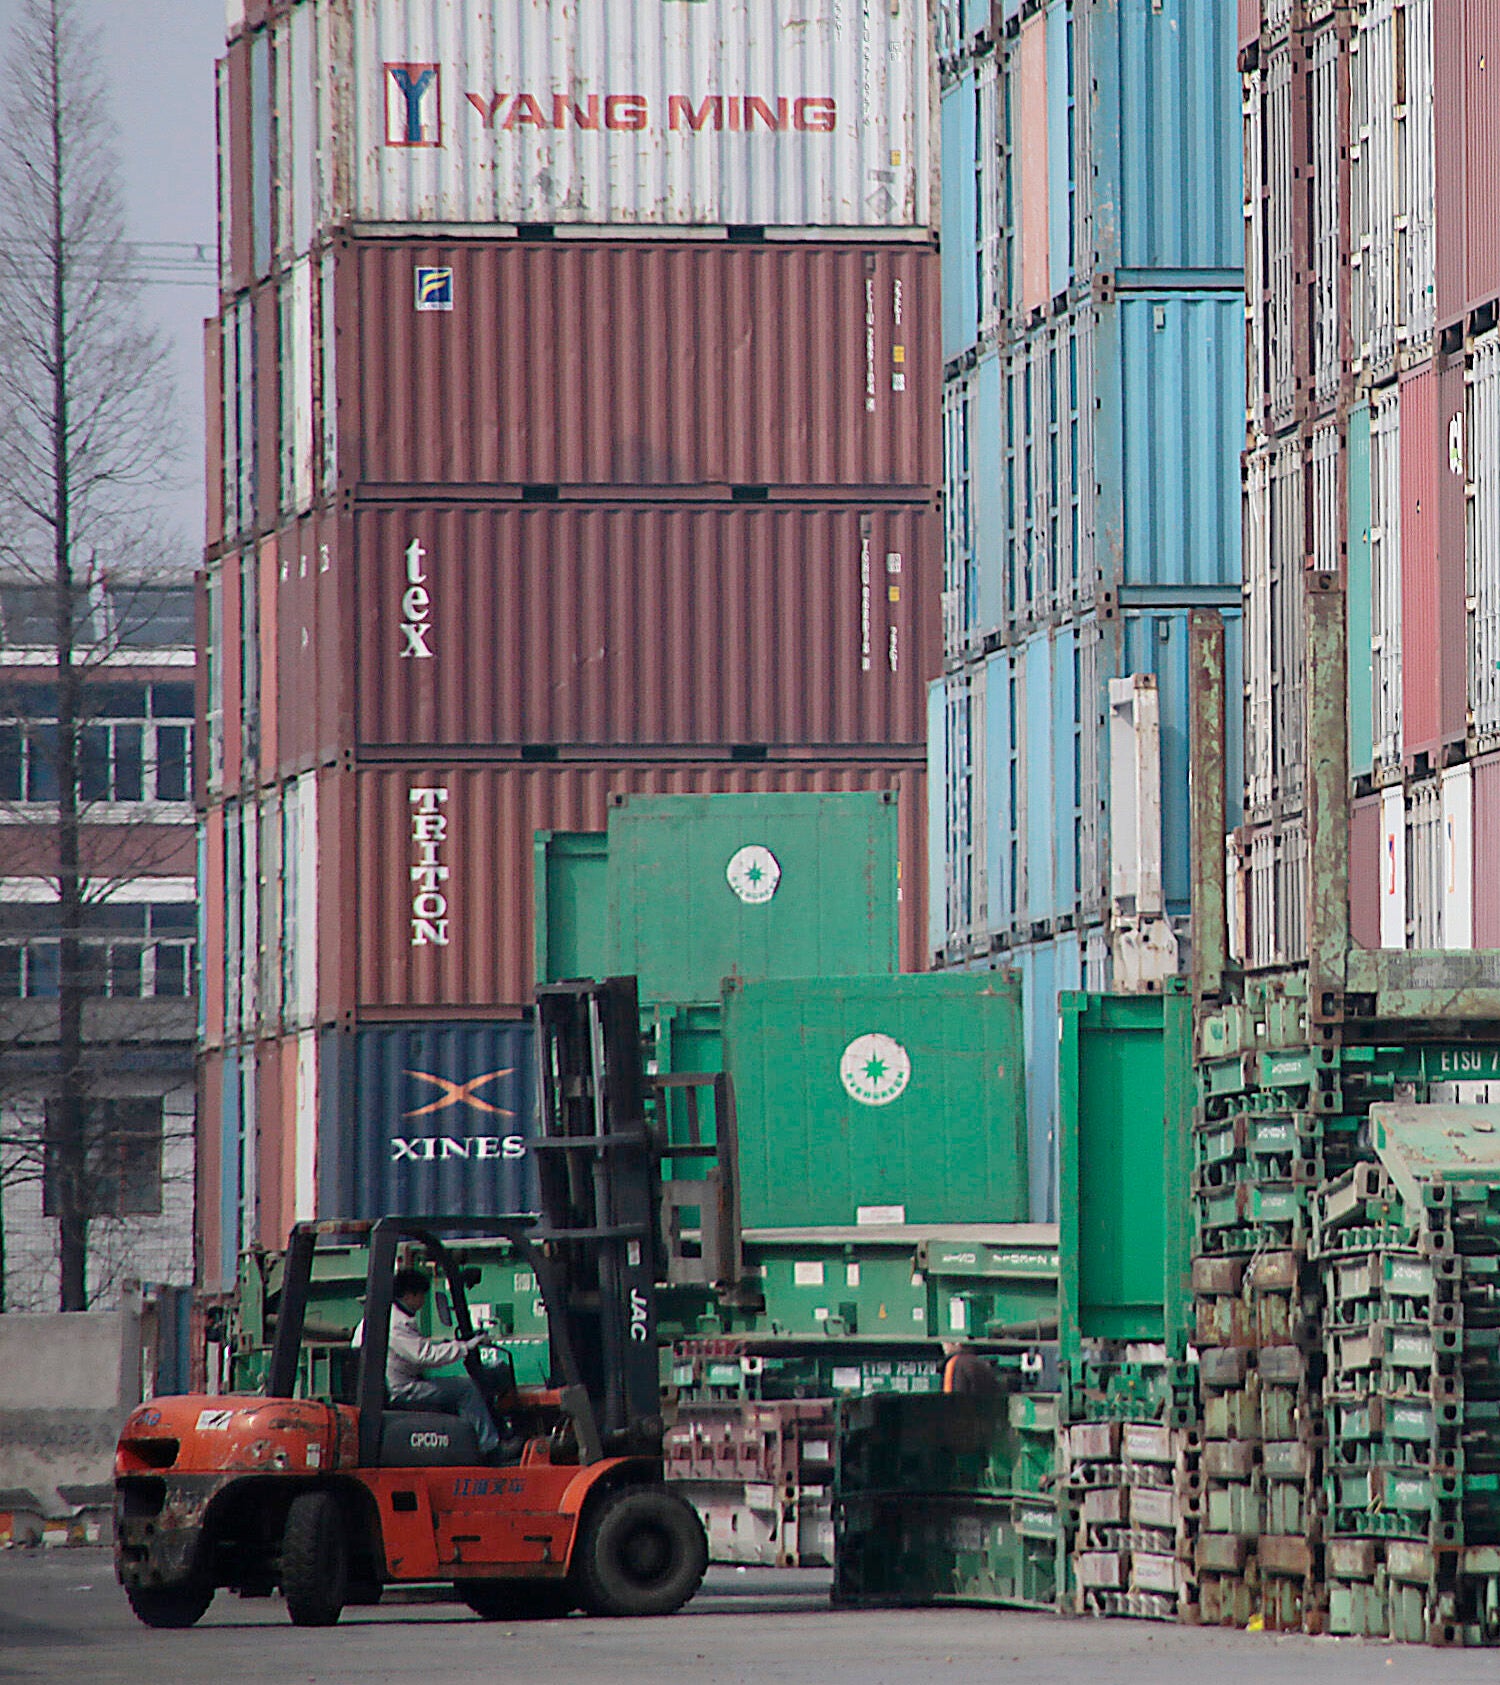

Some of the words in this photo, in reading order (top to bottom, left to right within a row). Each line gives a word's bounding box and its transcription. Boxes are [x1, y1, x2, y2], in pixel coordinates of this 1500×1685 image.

[464, 92, 648, 132] YANG
[668, 94, 837, 133] MING
[400, 538, 434, 658] tex
[409, 787, 450, 946] TRITON
[1441, 1050, 1482, 1071] EISU
[390, 1135, 526, 1161] XINES
[630, 1288, 648, 1341] JAC
